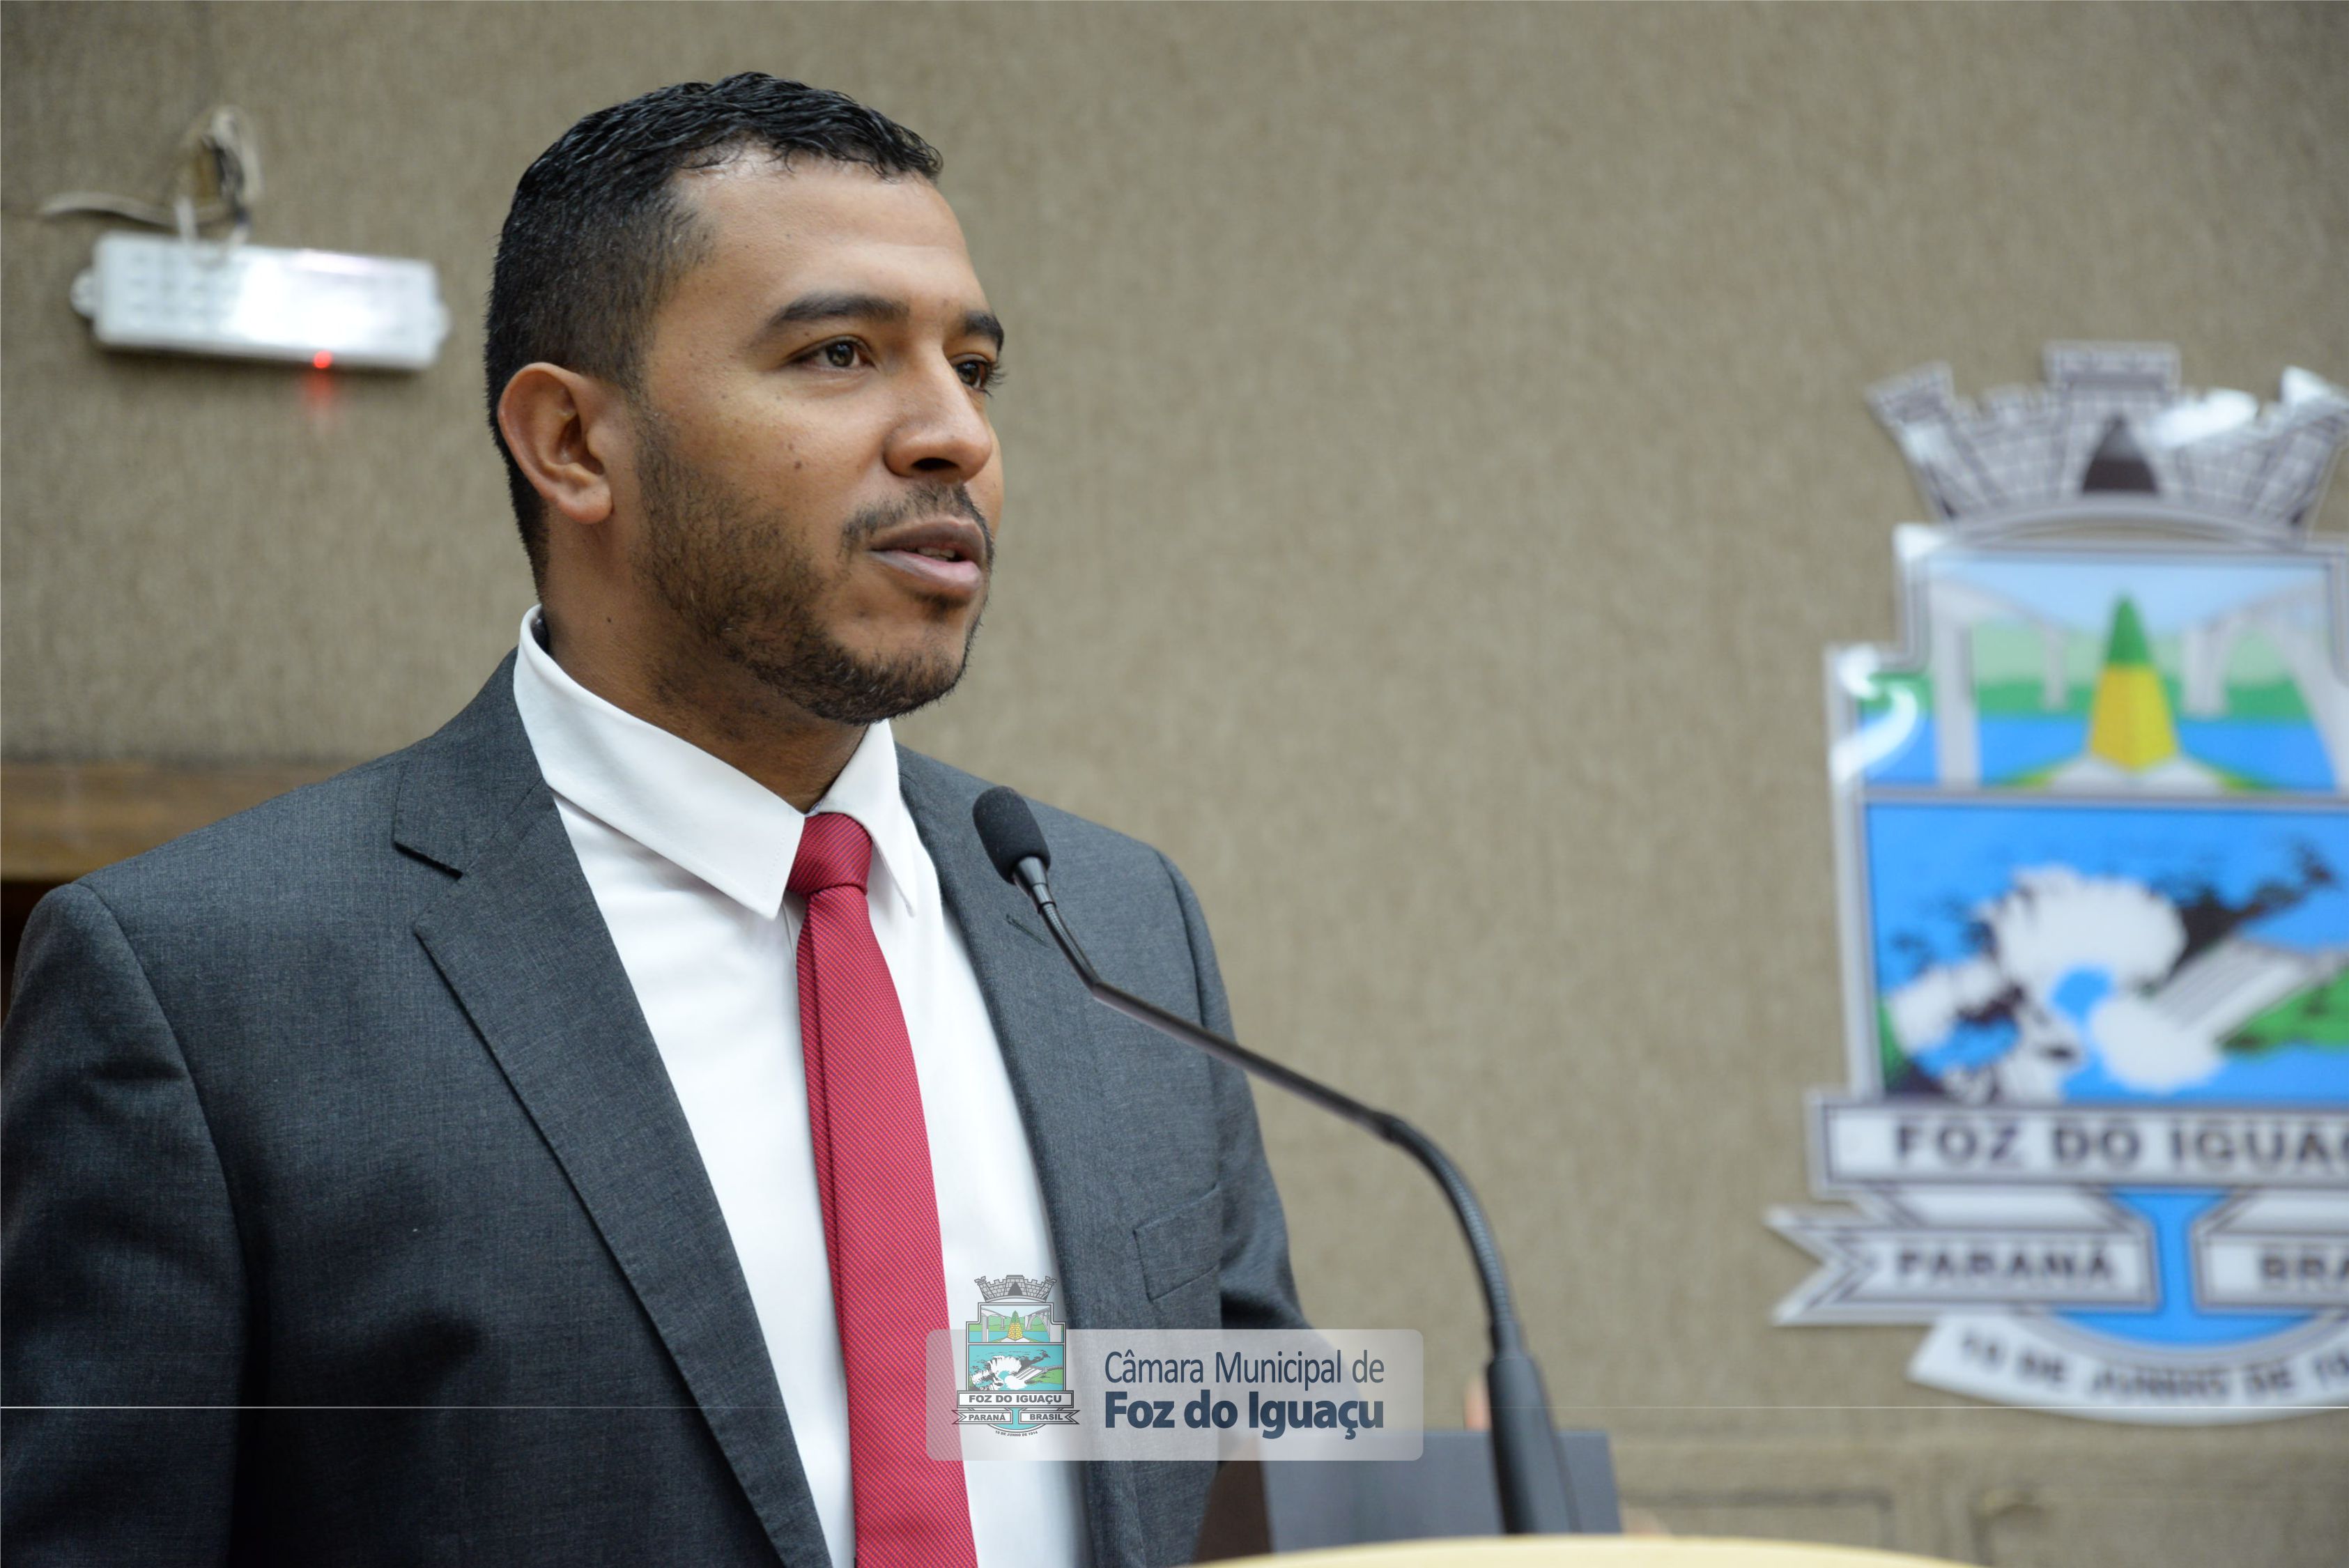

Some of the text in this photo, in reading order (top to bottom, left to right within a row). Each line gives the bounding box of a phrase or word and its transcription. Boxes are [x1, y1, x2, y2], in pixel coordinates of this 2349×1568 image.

[1897, 1123, 2349, 1167] FOZ DO IGUA
